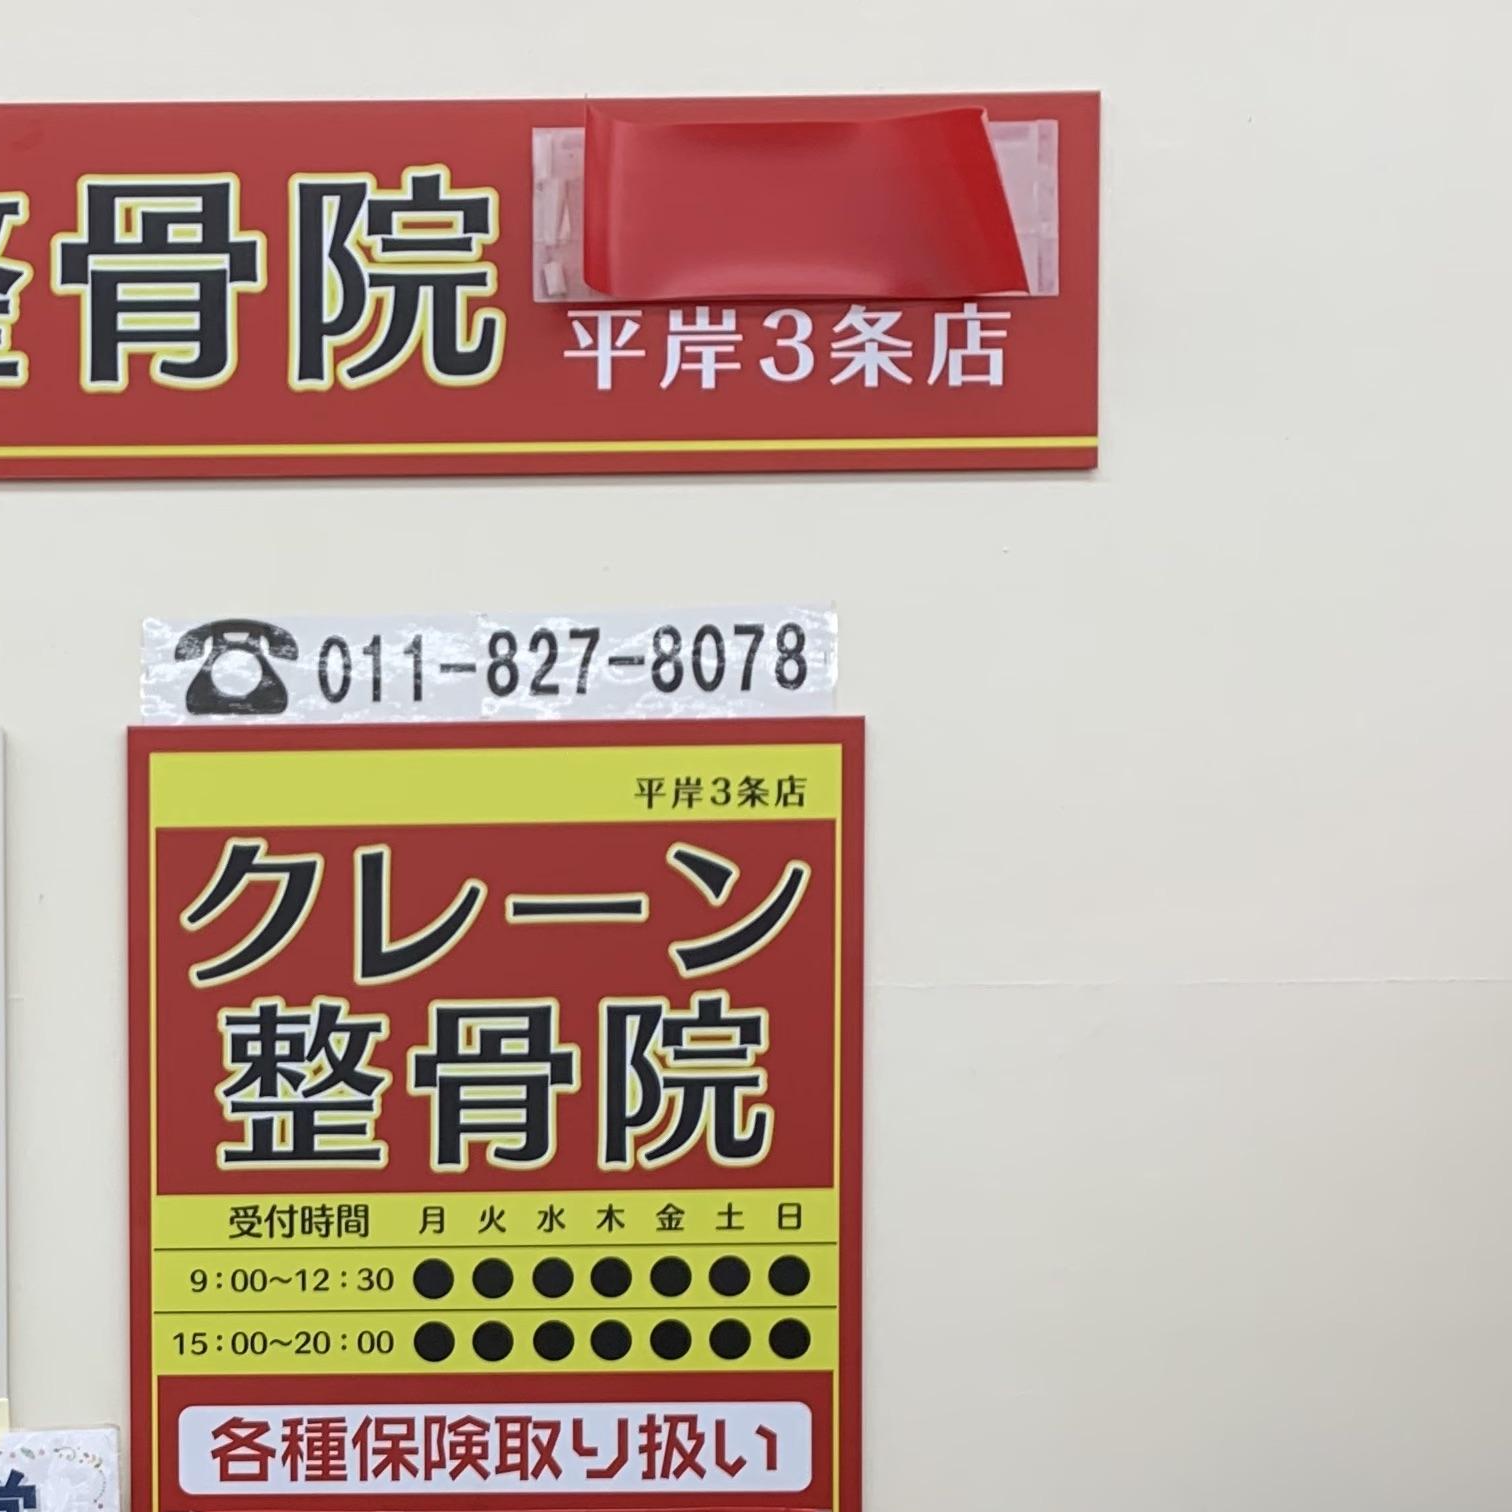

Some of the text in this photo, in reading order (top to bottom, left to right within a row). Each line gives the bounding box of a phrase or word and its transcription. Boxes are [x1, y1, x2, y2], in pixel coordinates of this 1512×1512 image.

[563, 302, 1012, 390] 平岸3条店
[318, 622, 808, 704] 011-827-8078
[634, 774, 808, 810] 平岸3条店
[179, 836, 812, 989] クレーン
[216, 989, 775, 1174] 整骨院
[228, 1202, 802, 1240] 受付時間 月 火 水 木 金 土 日
[210, 1413, 779, 1483] 各種保険取り扱い
